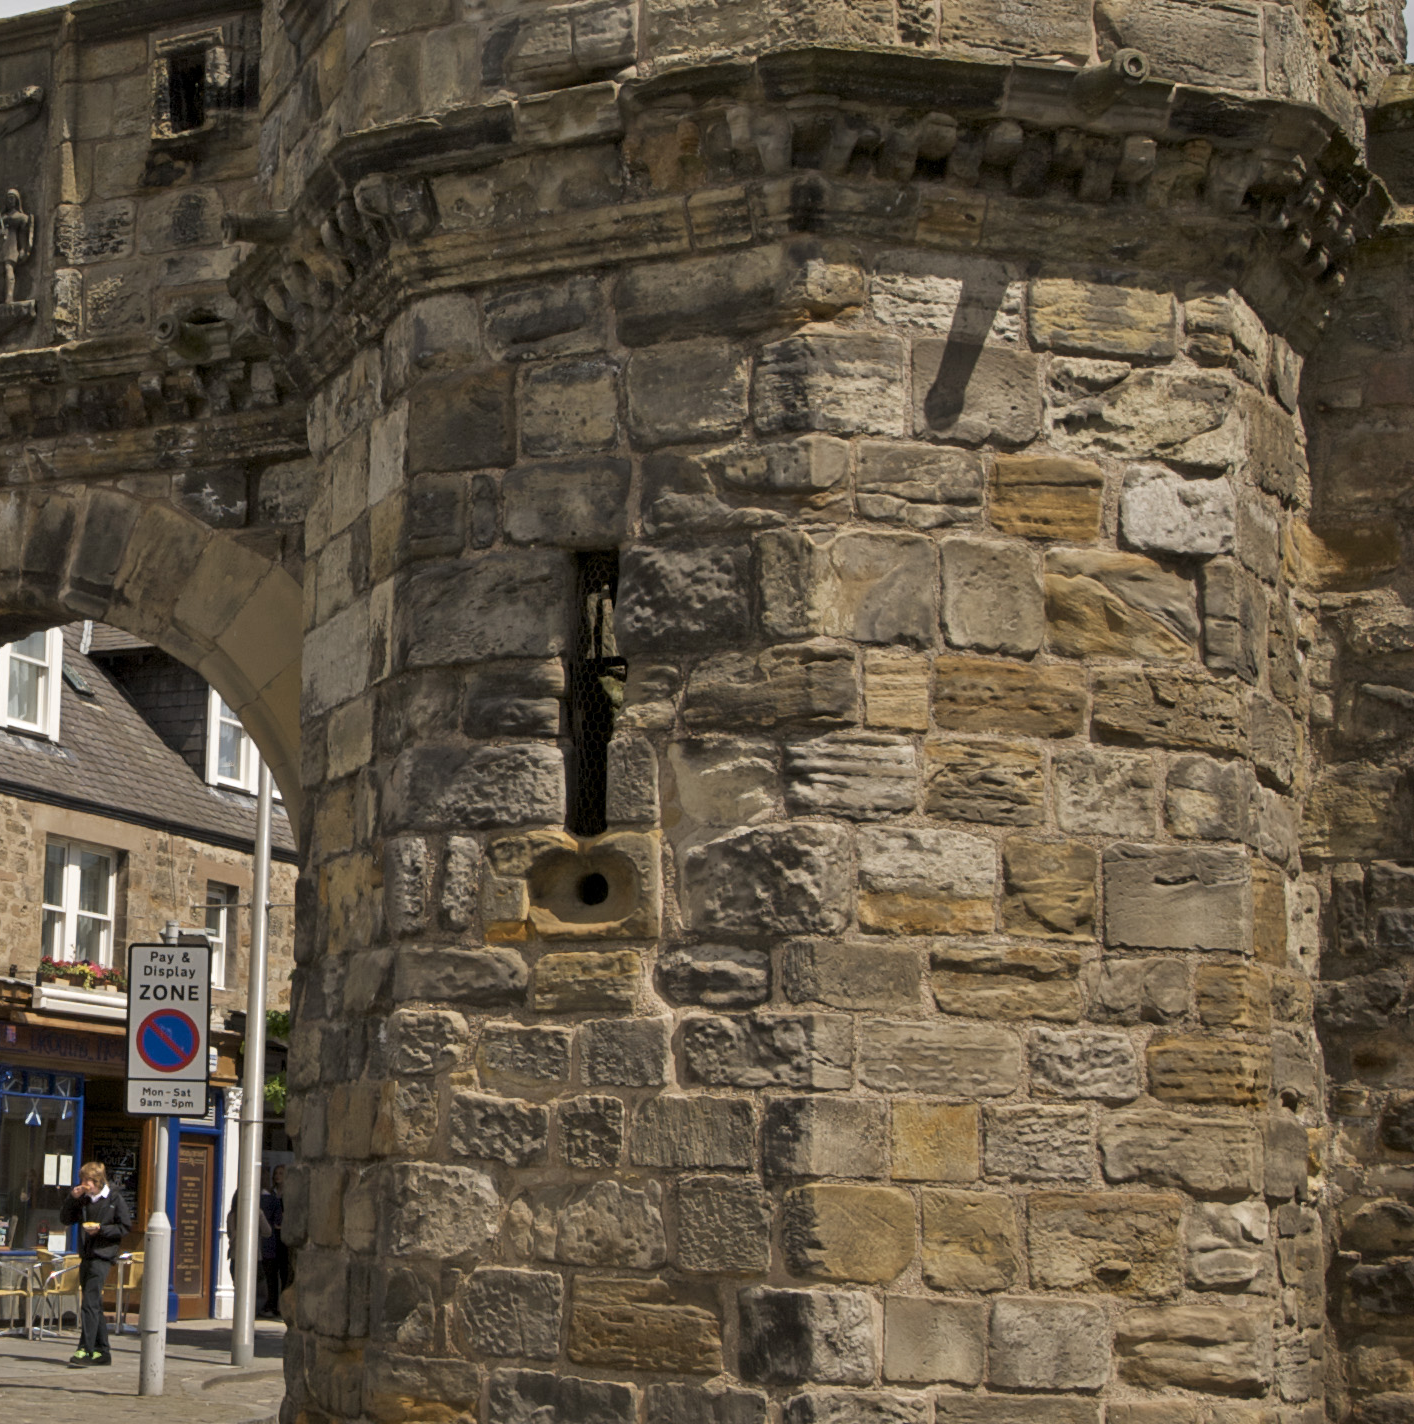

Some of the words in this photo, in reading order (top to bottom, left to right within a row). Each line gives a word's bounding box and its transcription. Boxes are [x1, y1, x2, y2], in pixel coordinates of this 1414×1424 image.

[150, 951, 174, 964] Pay
[182, 952, 190, 963] &
[144, 965, 196, 979] Display
[139, 984, 199, 1001] ZONE
[142, 1087, 163, 1096] Mon
[174, 1088, 191, 1097] Sat
[140, 1098, 162, 1107] 9am
[171, 1099, 194, 1109] 5pm
